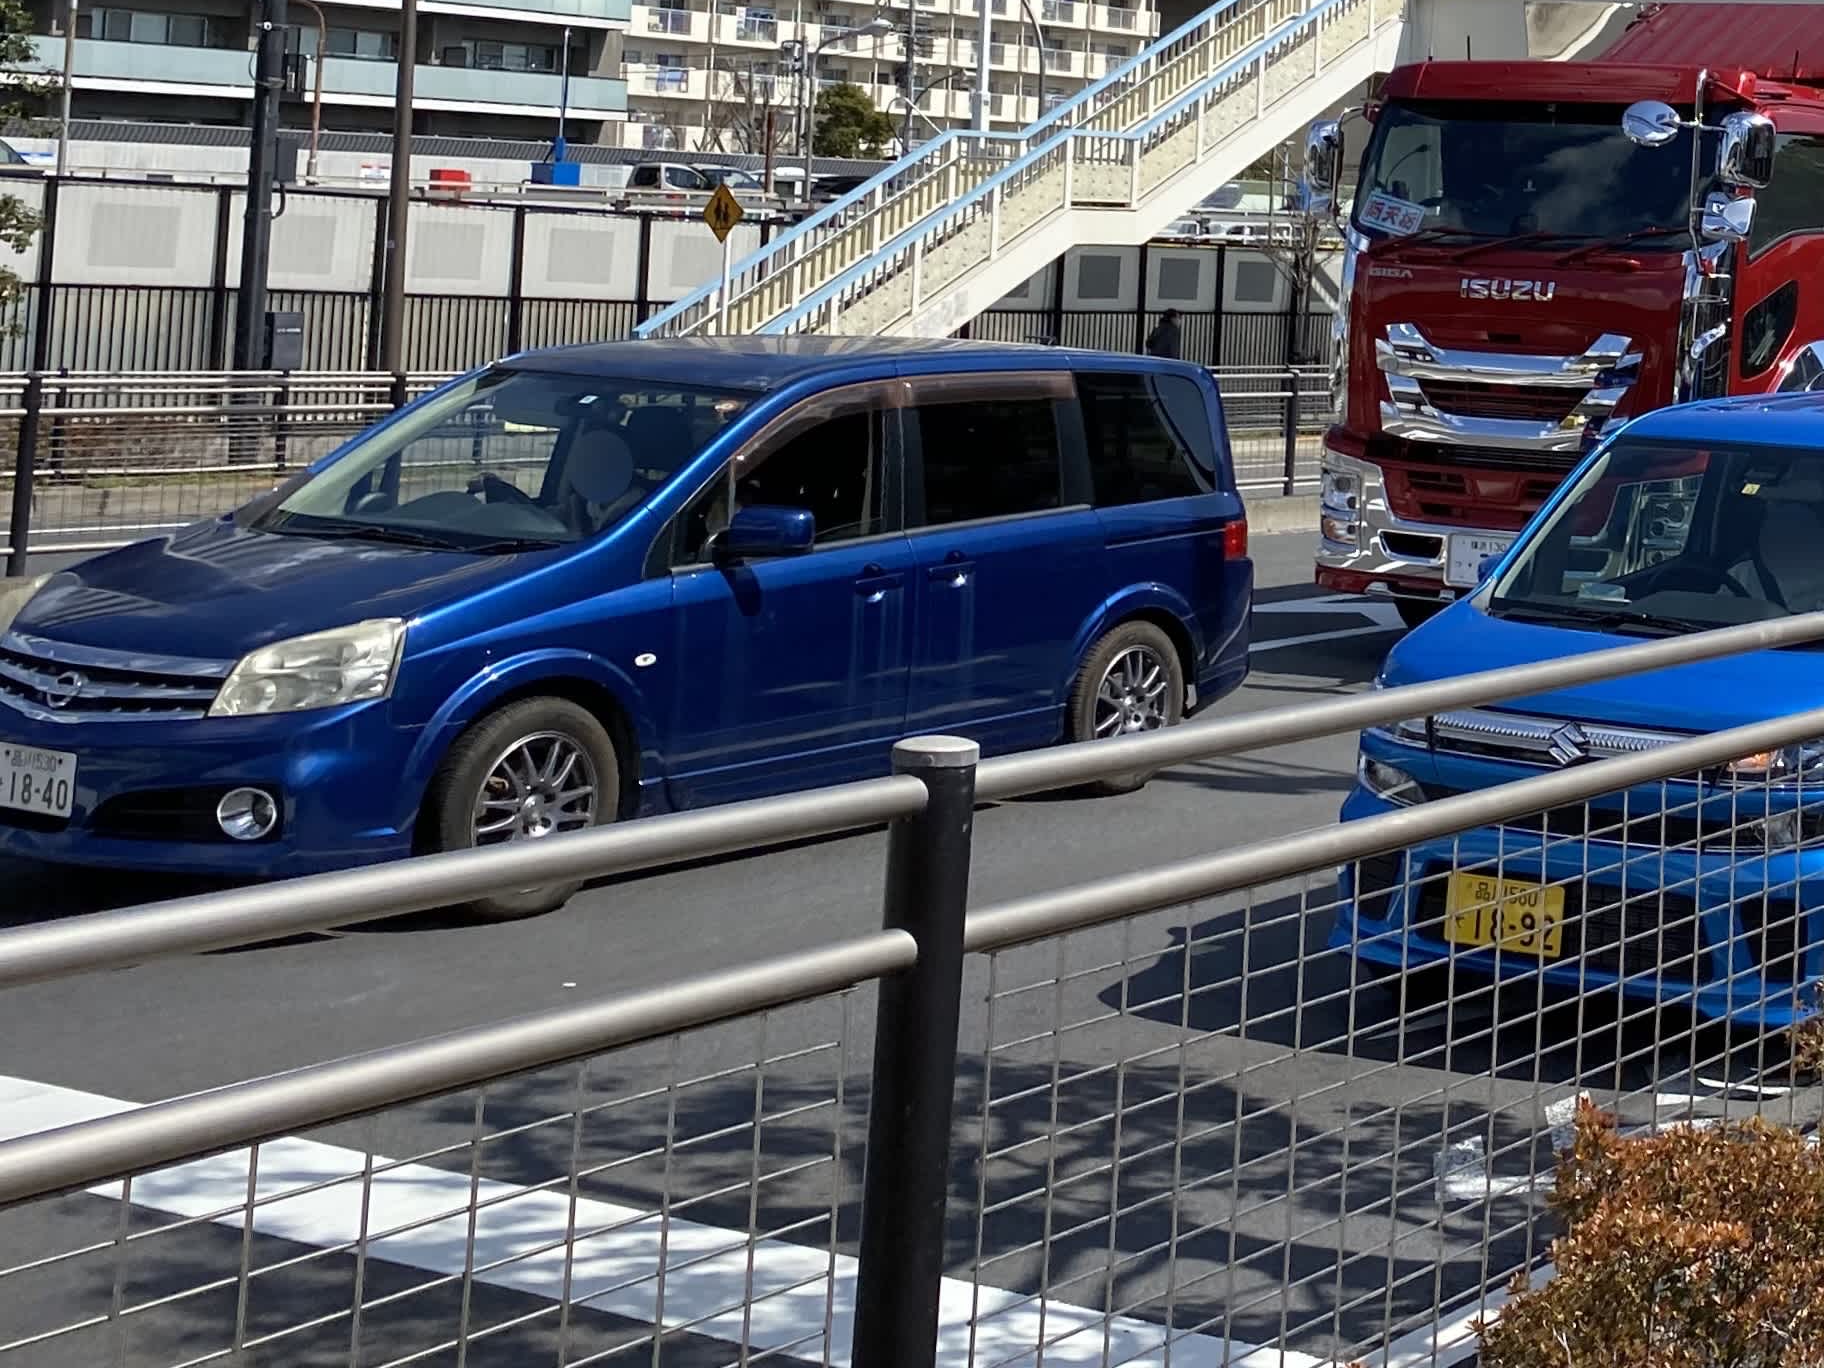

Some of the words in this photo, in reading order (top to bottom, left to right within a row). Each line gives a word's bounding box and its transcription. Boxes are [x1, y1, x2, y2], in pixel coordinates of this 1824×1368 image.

[1369, 267, 1413, 280] GIGA
[1460, 278, 1556, 302] ISUZU
[9, 771, 69, 811] 18-40
[1474, 907, 1555, 952] 18-92
